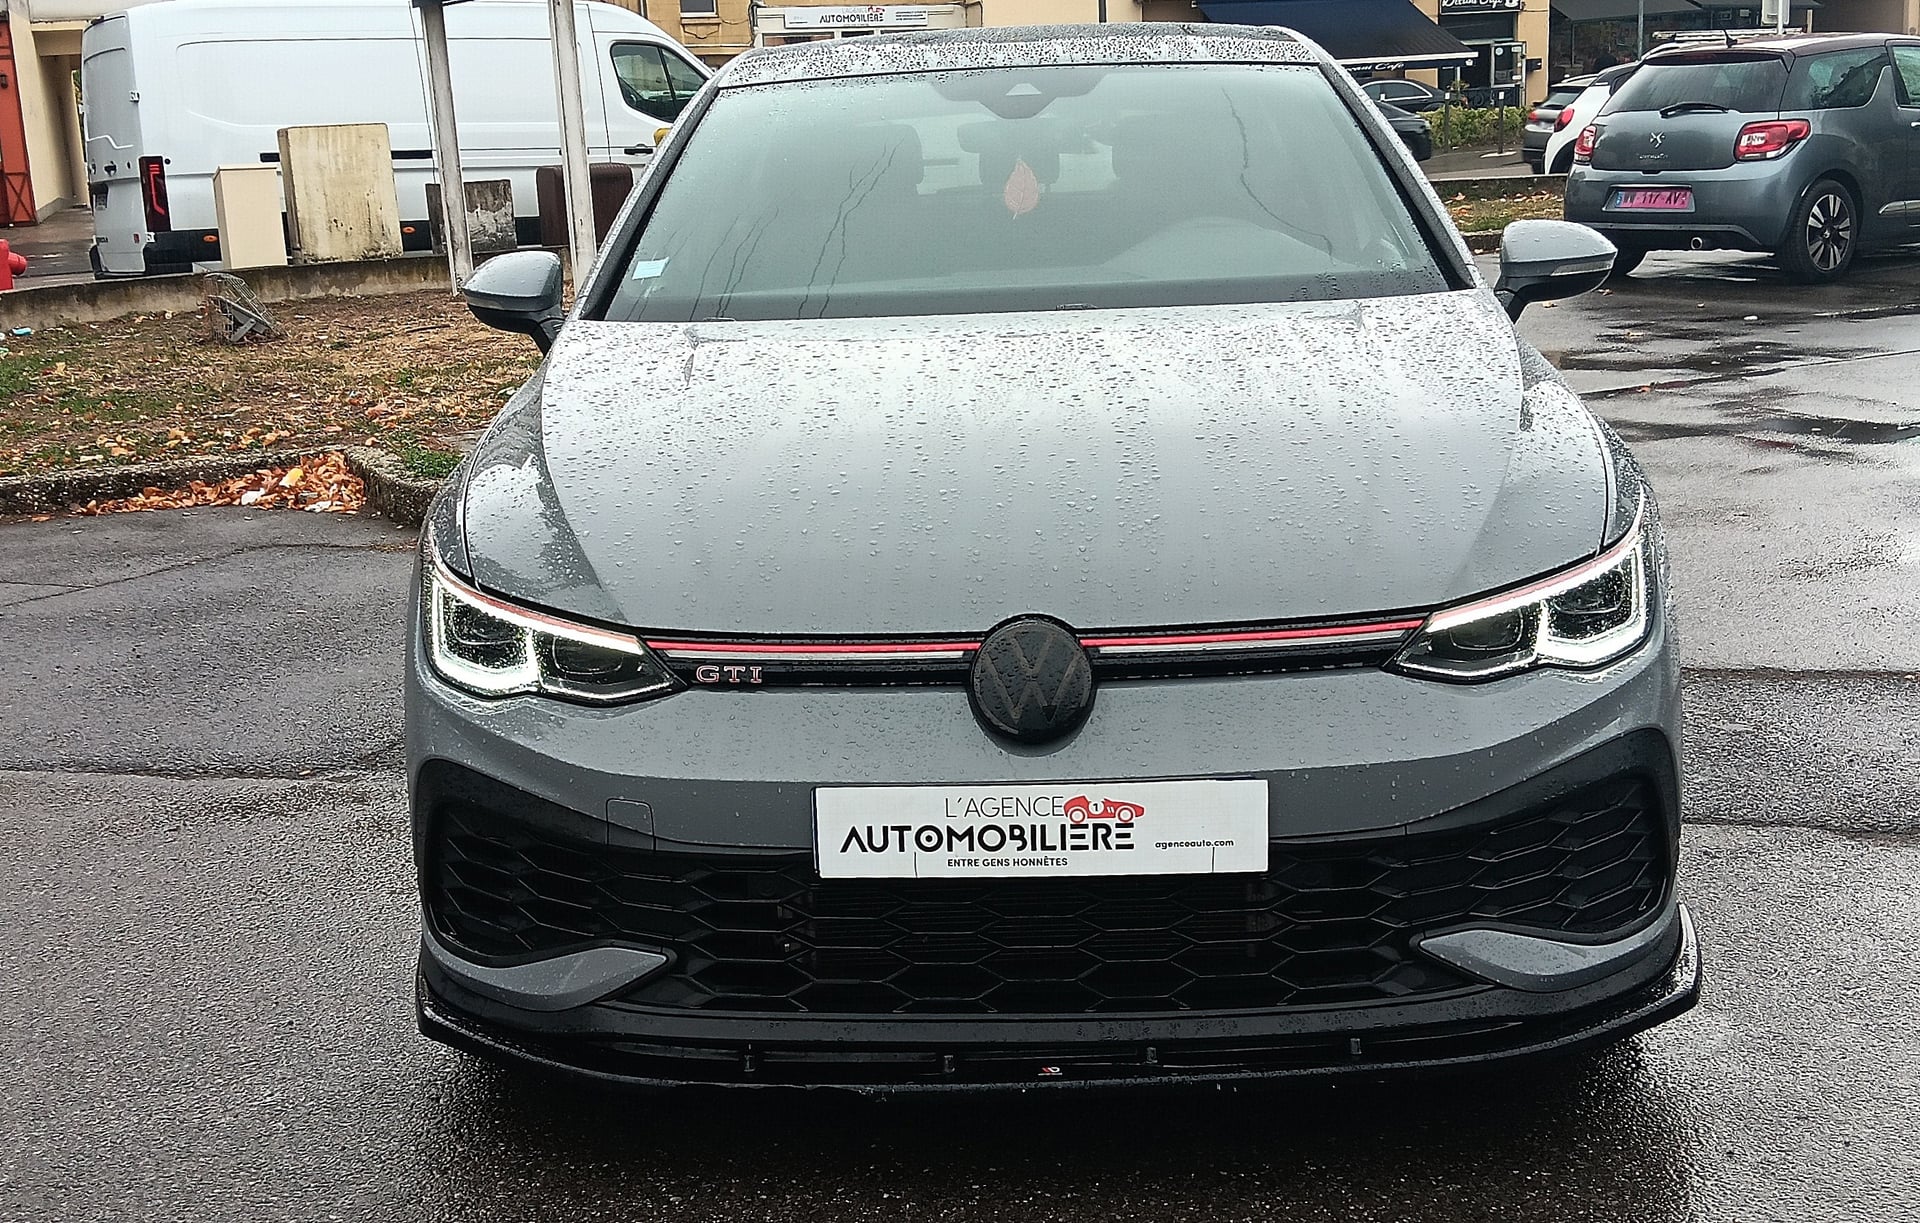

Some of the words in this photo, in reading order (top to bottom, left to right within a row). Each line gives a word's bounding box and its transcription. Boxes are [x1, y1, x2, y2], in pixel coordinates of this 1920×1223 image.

[696, 664, 762, 684] GTI
[945, 796, 1064, 818] L'AGENCE
[1154, 838, 1234, 849] agenceauto.com
[947, 858, 979, 867] ENTRE
[982, 858, 1010, 867] GENS
[1013, 855, 1068, 866] HONNÊTES
